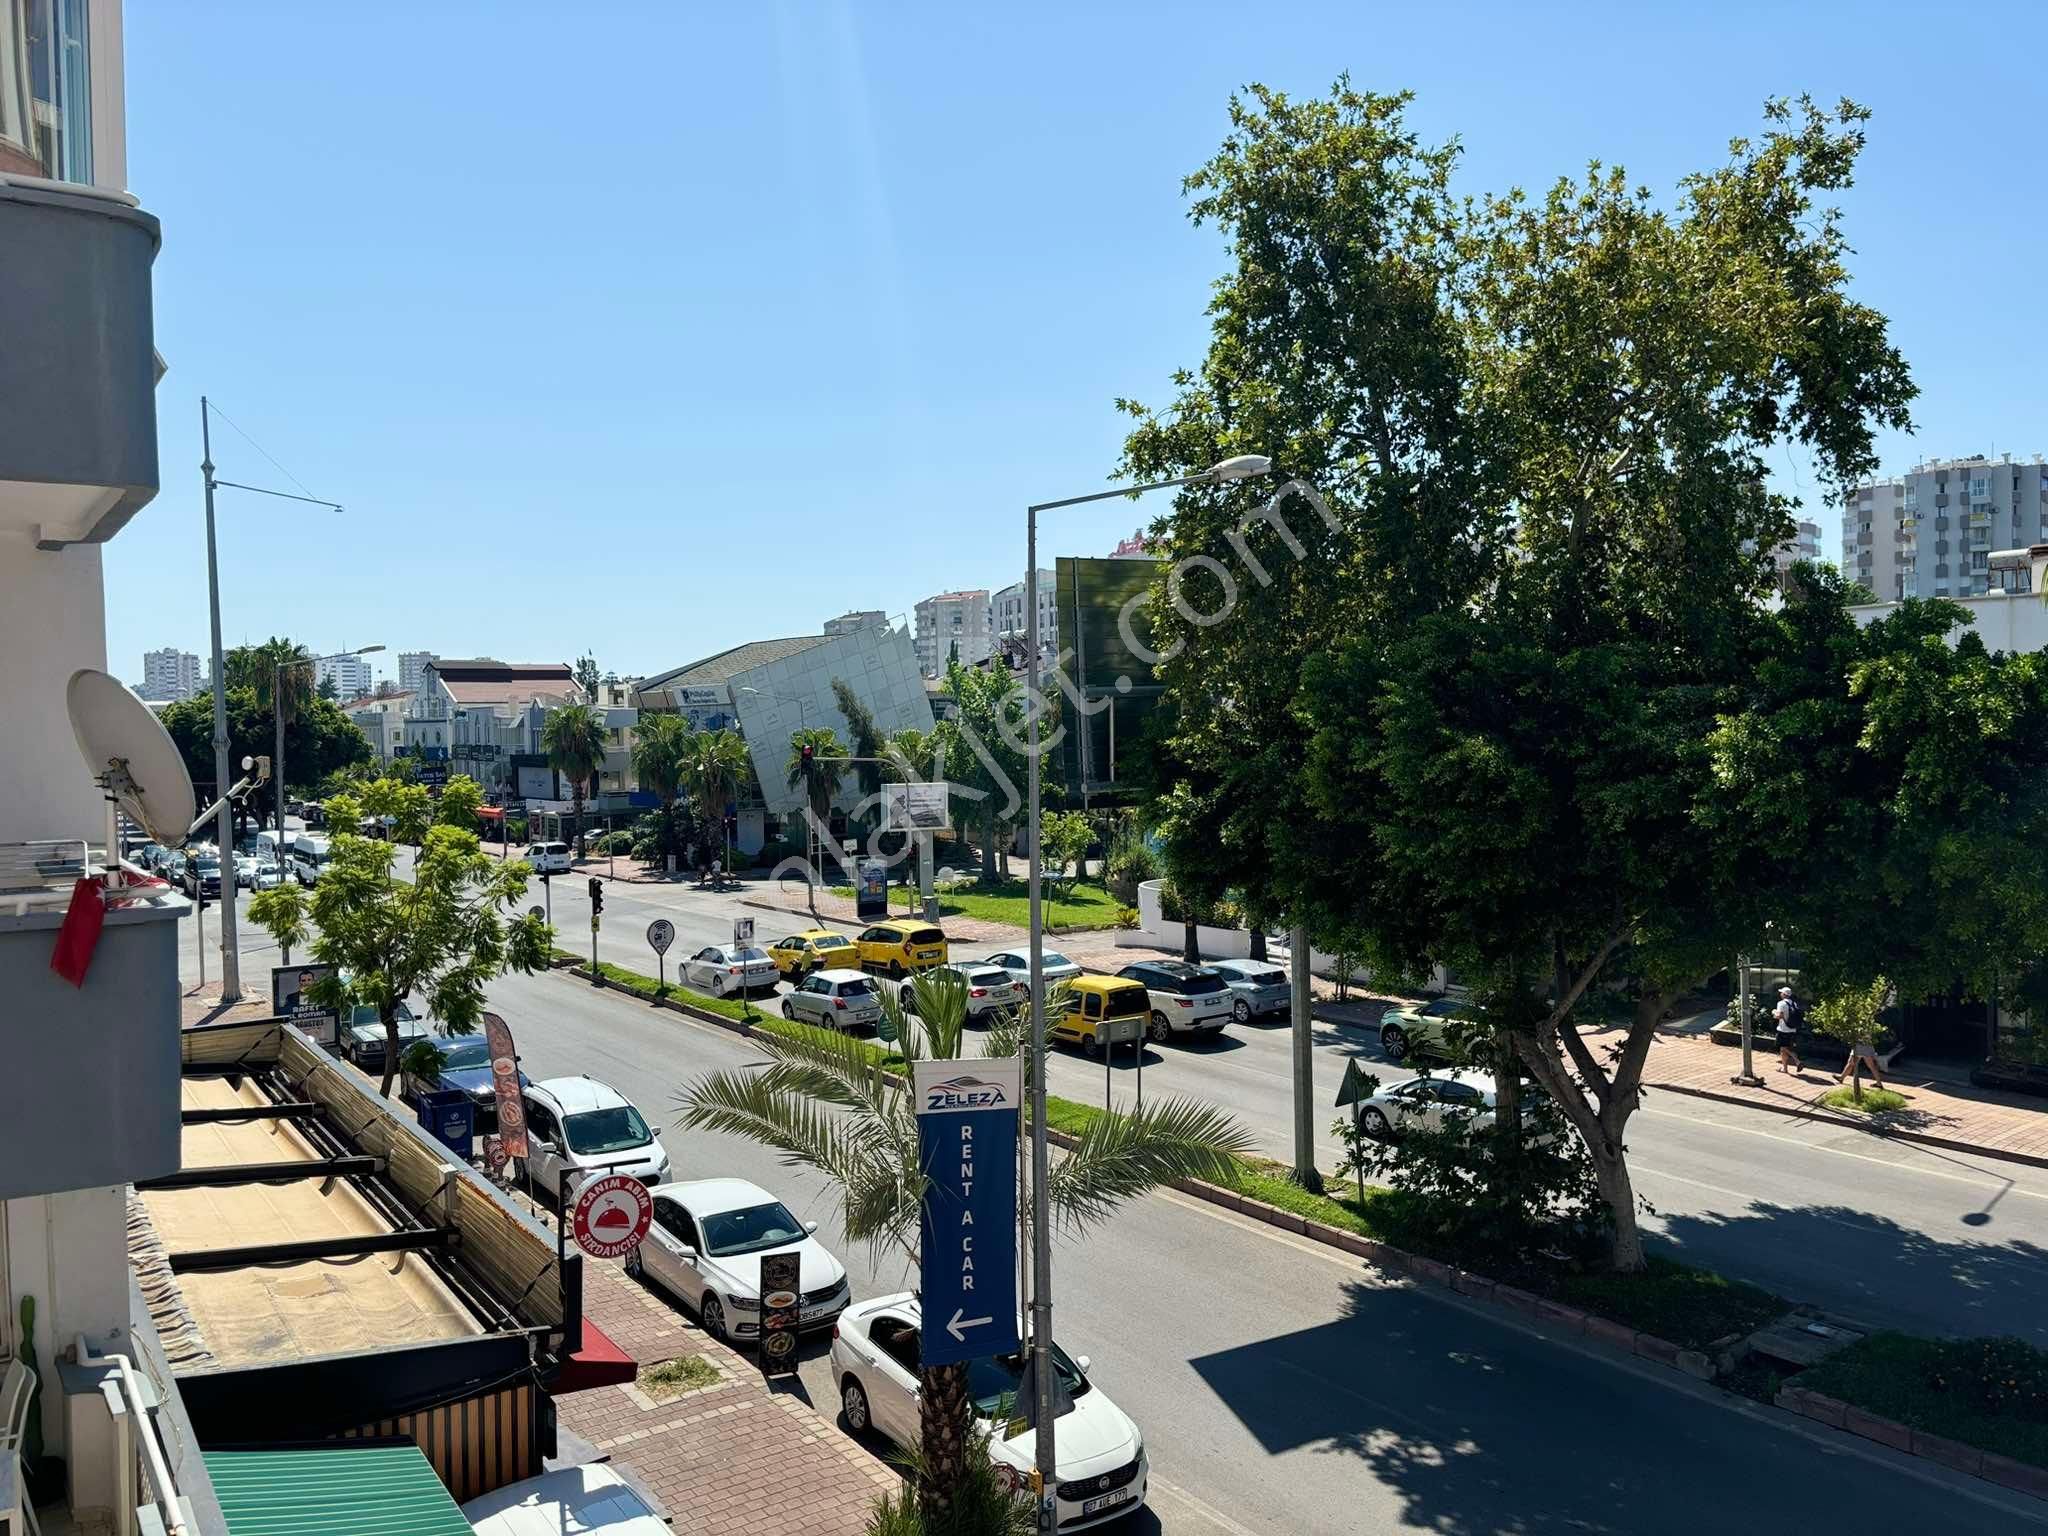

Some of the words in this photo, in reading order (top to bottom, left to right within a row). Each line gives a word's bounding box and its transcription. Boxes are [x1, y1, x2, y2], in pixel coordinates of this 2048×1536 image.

[928, 1089, 1007, 1110] ZELEZA
[961, 1125, 973, 1197] RENT
[581, 1178, 621, 1207] CANIM
[961, 1210, 973, 1225] A
[962, 1237, 974, 1290] CAR
